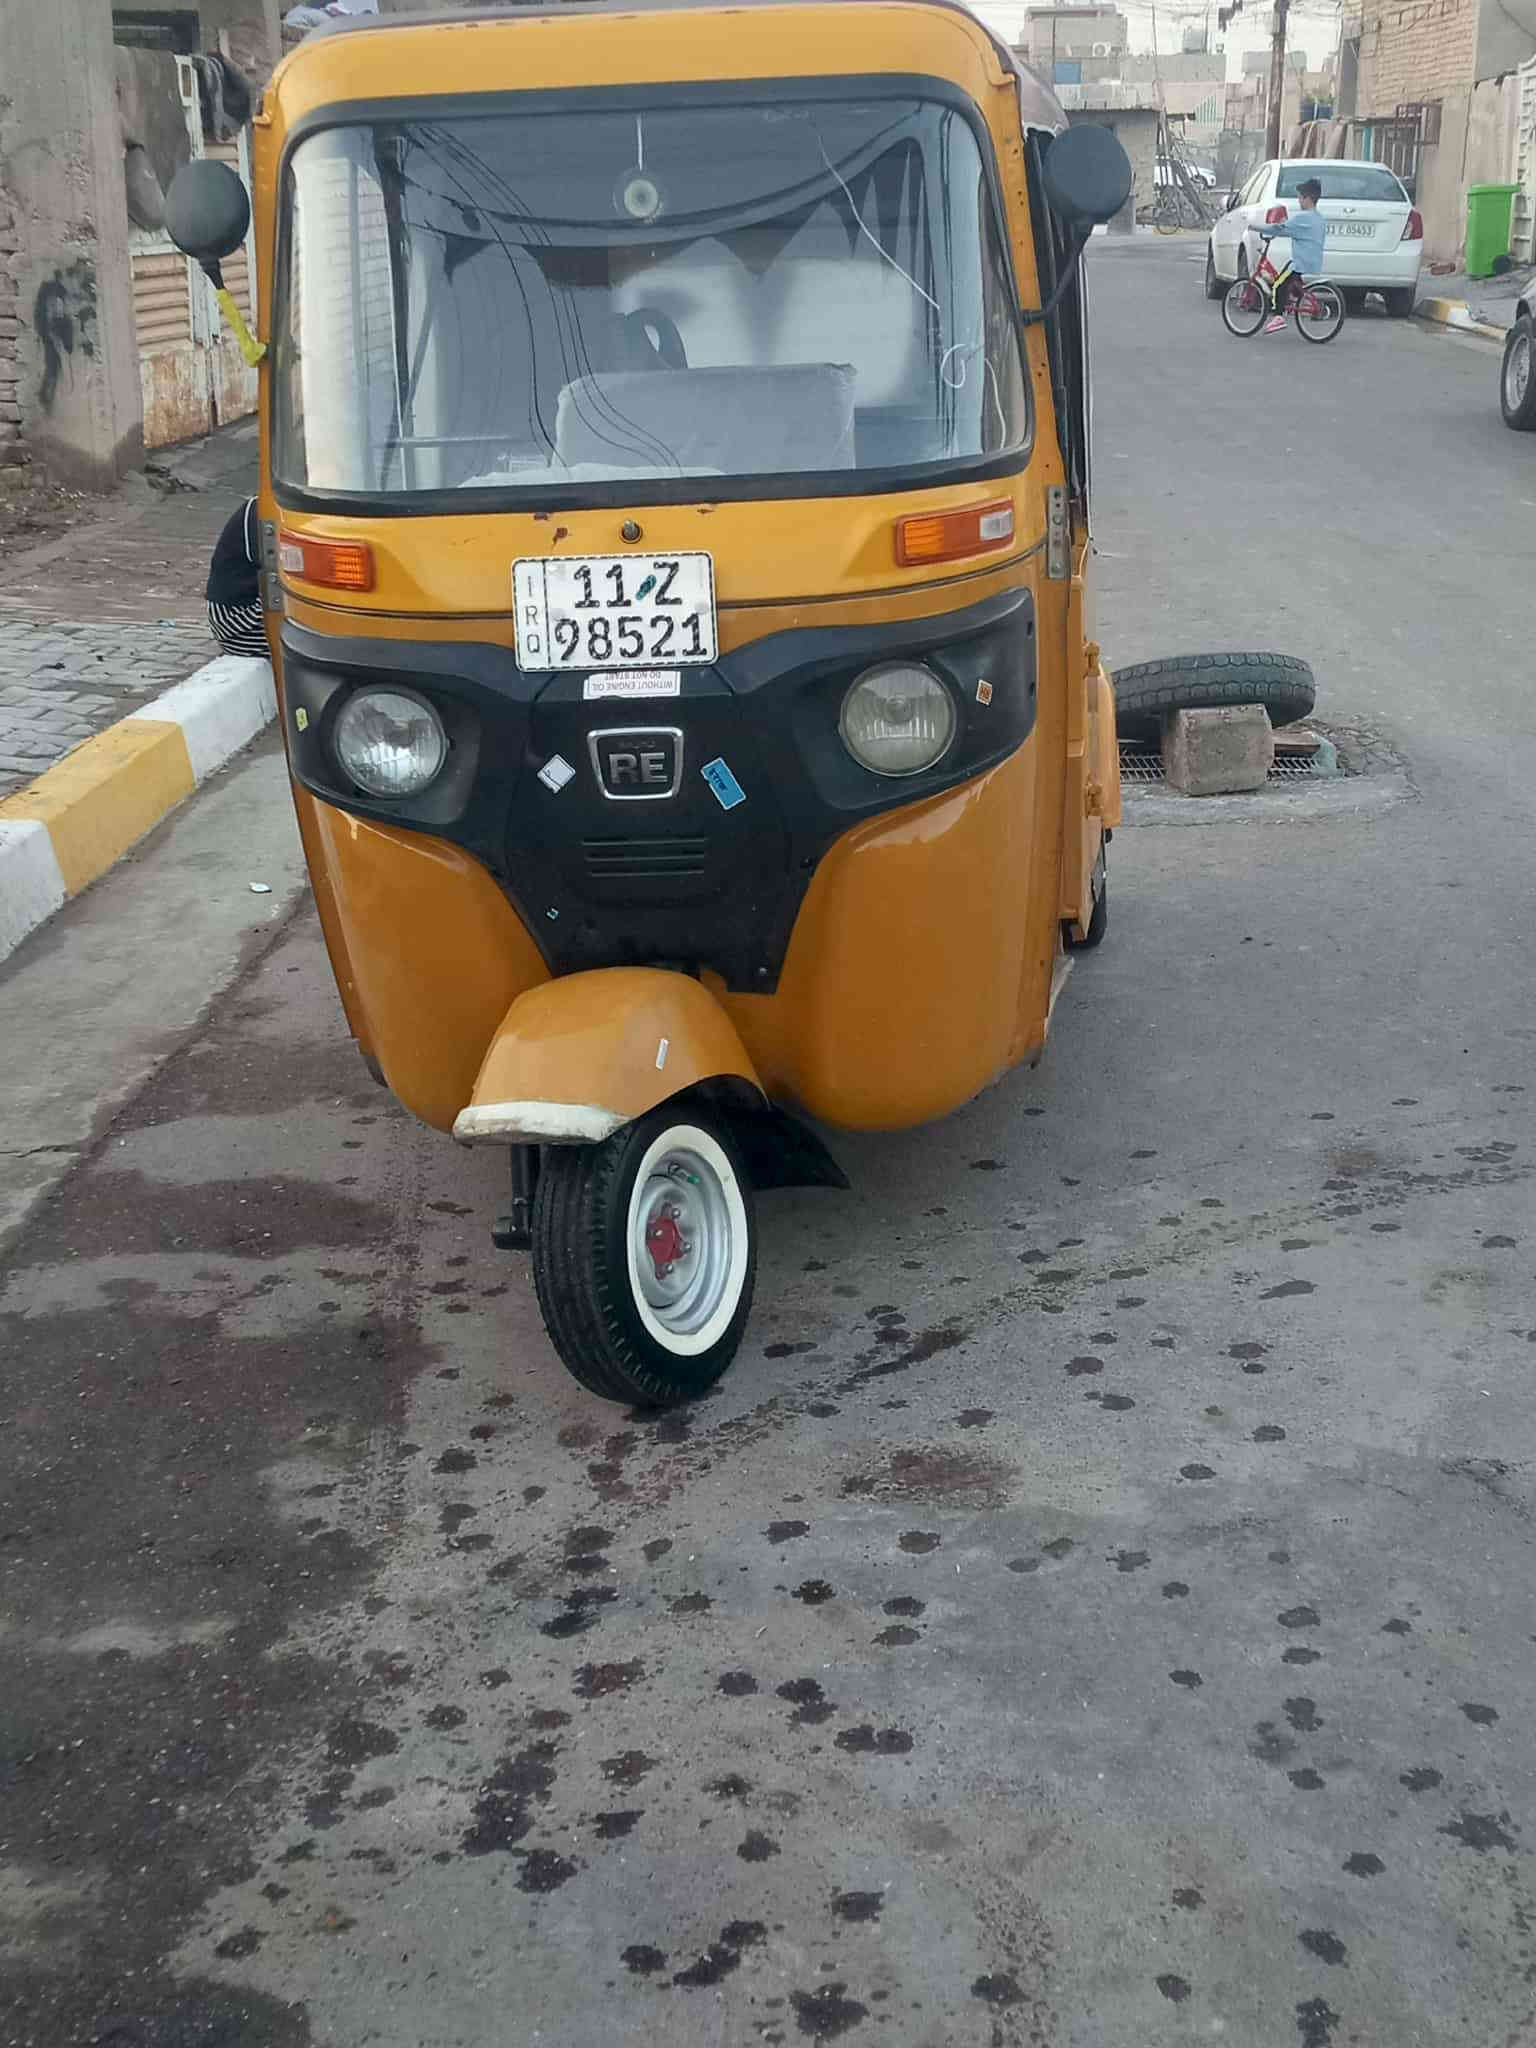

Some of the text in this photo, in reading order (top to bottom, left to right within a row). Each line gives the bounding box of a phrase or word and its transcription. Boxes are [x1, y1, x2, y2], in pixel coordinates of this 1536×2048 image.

[574, 561, 683, 608] 11 Z
[554, 612, 707, 661] 98521
[632, 671, 648, 680] NOT
[650, 671, 661, 679] DO
[606, 681, 636, 690] ENGINE
[639, 680, 672, 689] WITHOUT
[608, 752, 668, 784] RE
